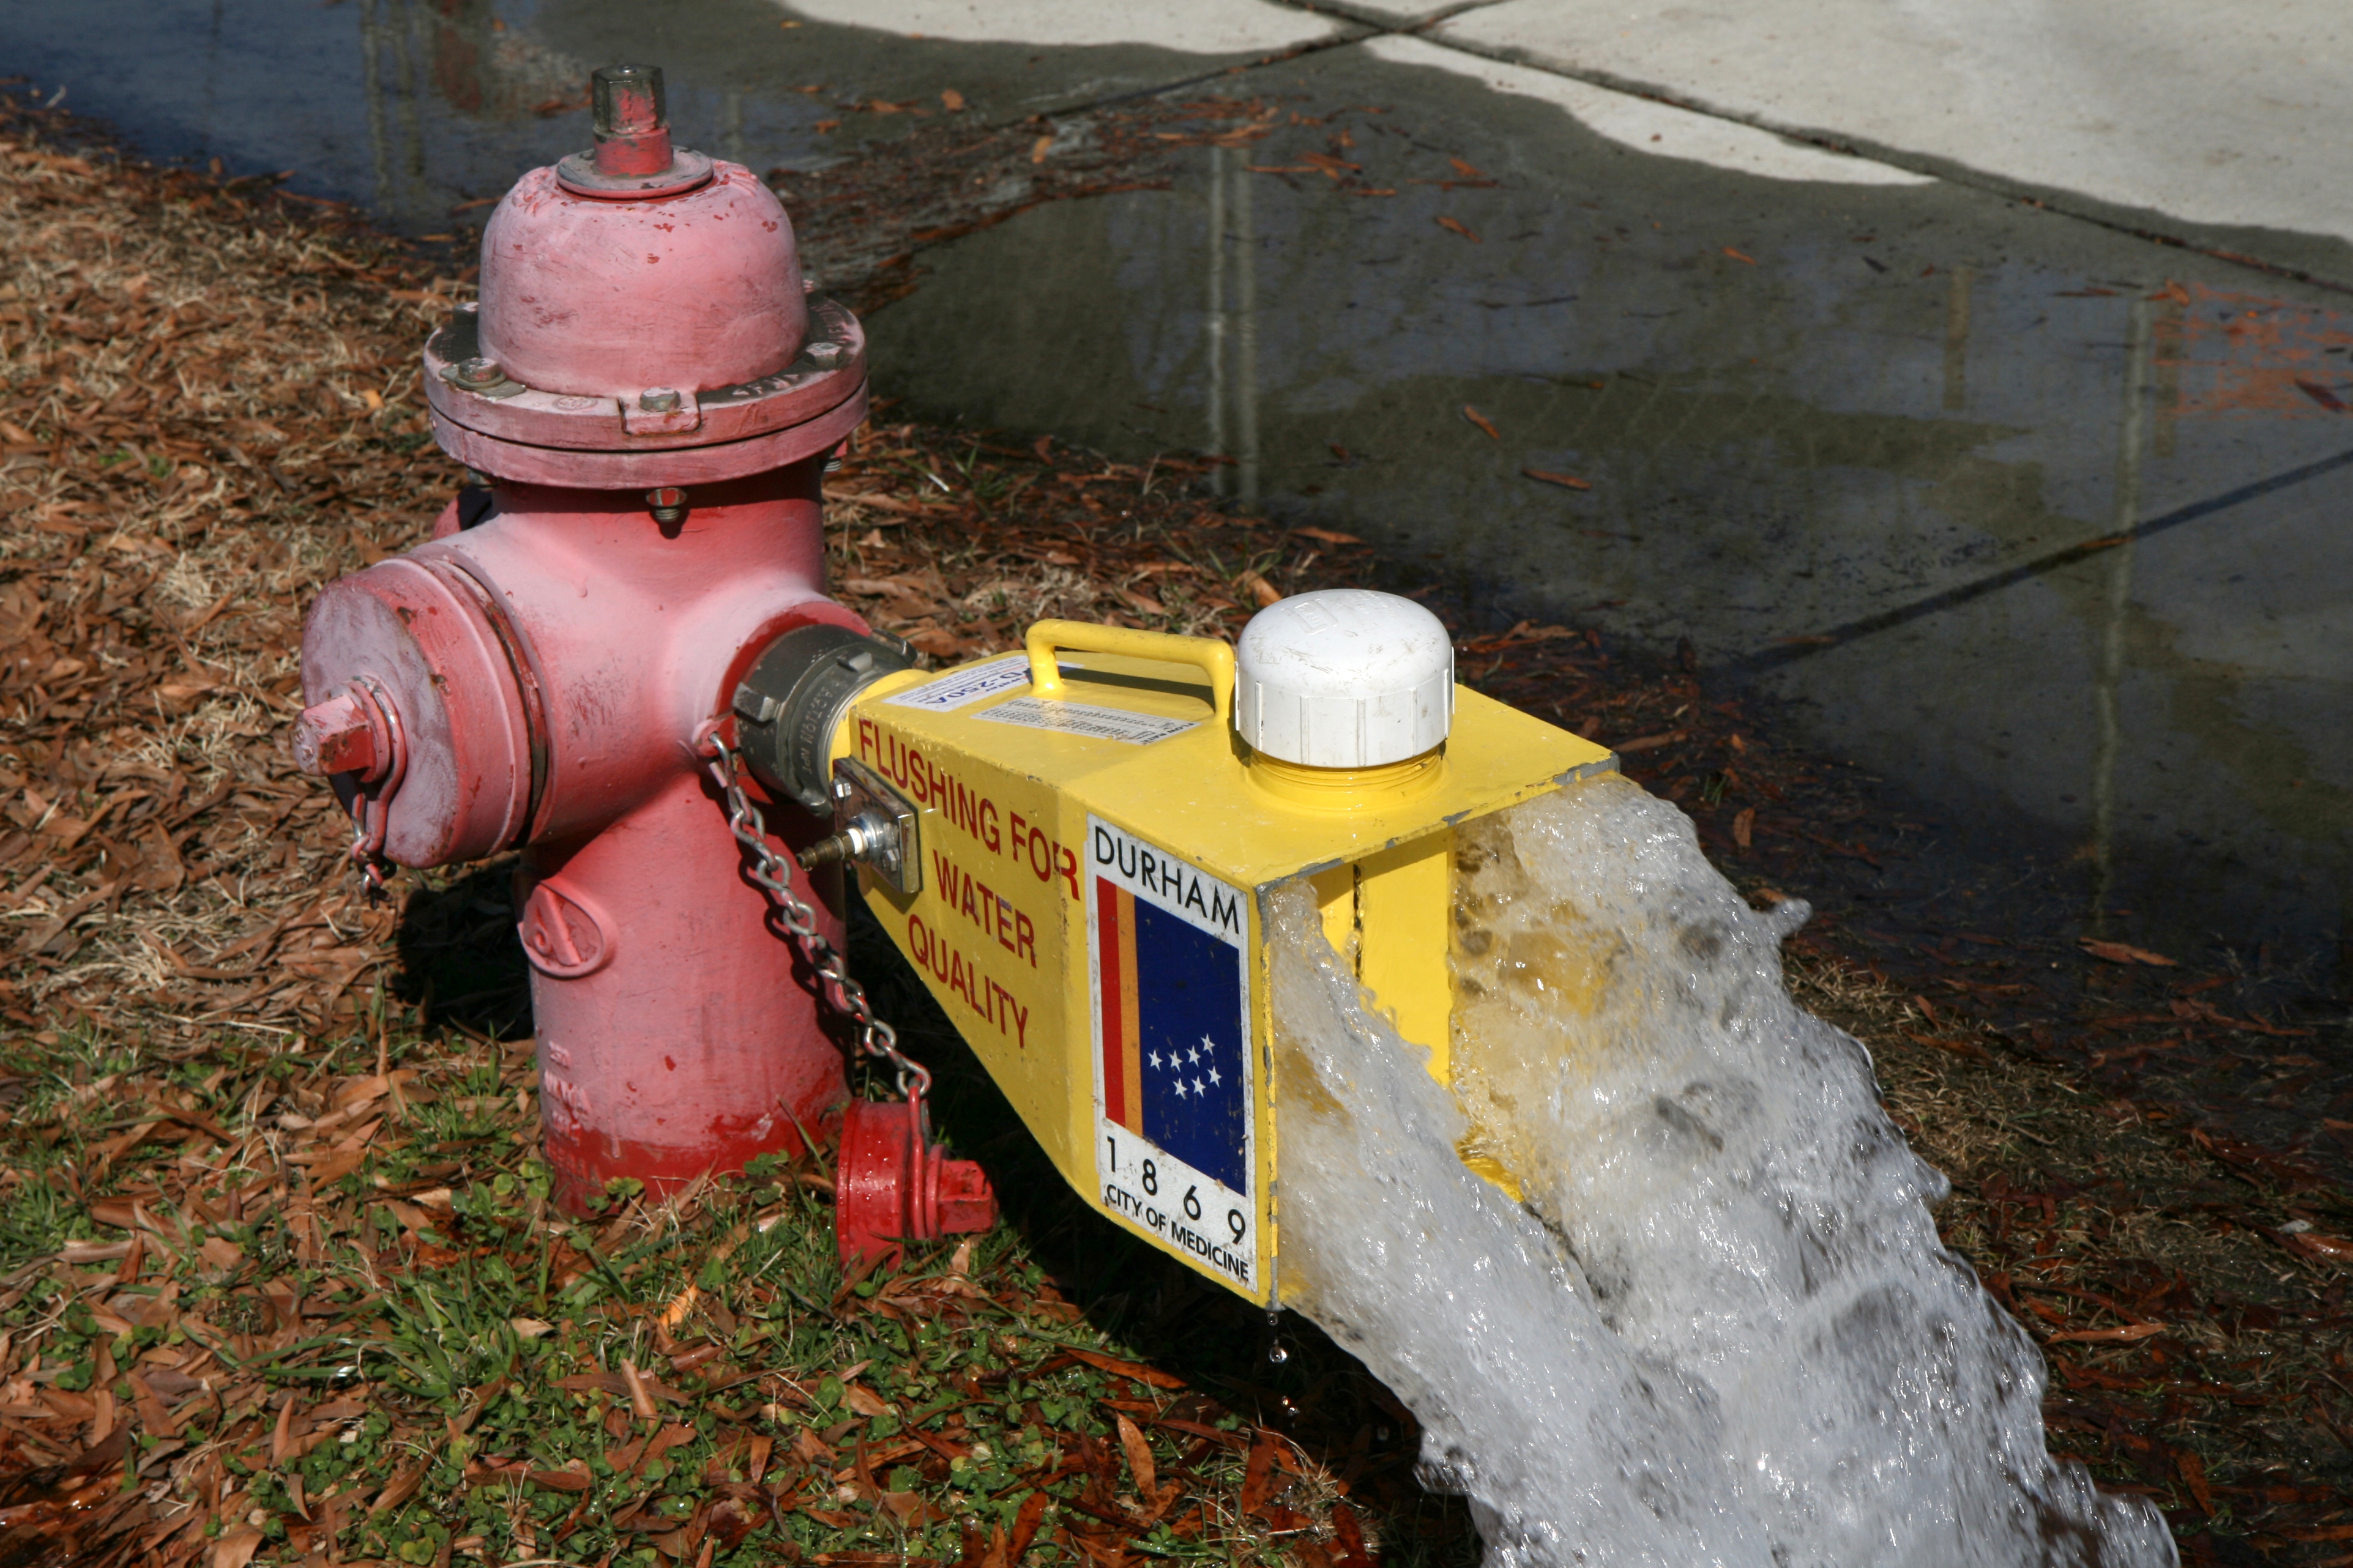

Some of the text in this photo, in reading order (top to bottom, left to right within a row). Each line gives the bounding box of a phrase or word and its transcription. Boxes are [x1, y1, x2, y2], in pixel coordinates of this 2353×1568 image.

[1167, 722, 1195, 734] FLOW
[859, 718, 1080, 901] FLUSHING FOR
[933, 849, 1037, 969] WATER
[1095, 825, 1239, 935] DURHAM
[908, 913, 1029, 1049] QUALITY
[1106, 1184, 1249, 1282] CITY OF MEDICINE
[1107, 1135, 1246, 1245] 1869
